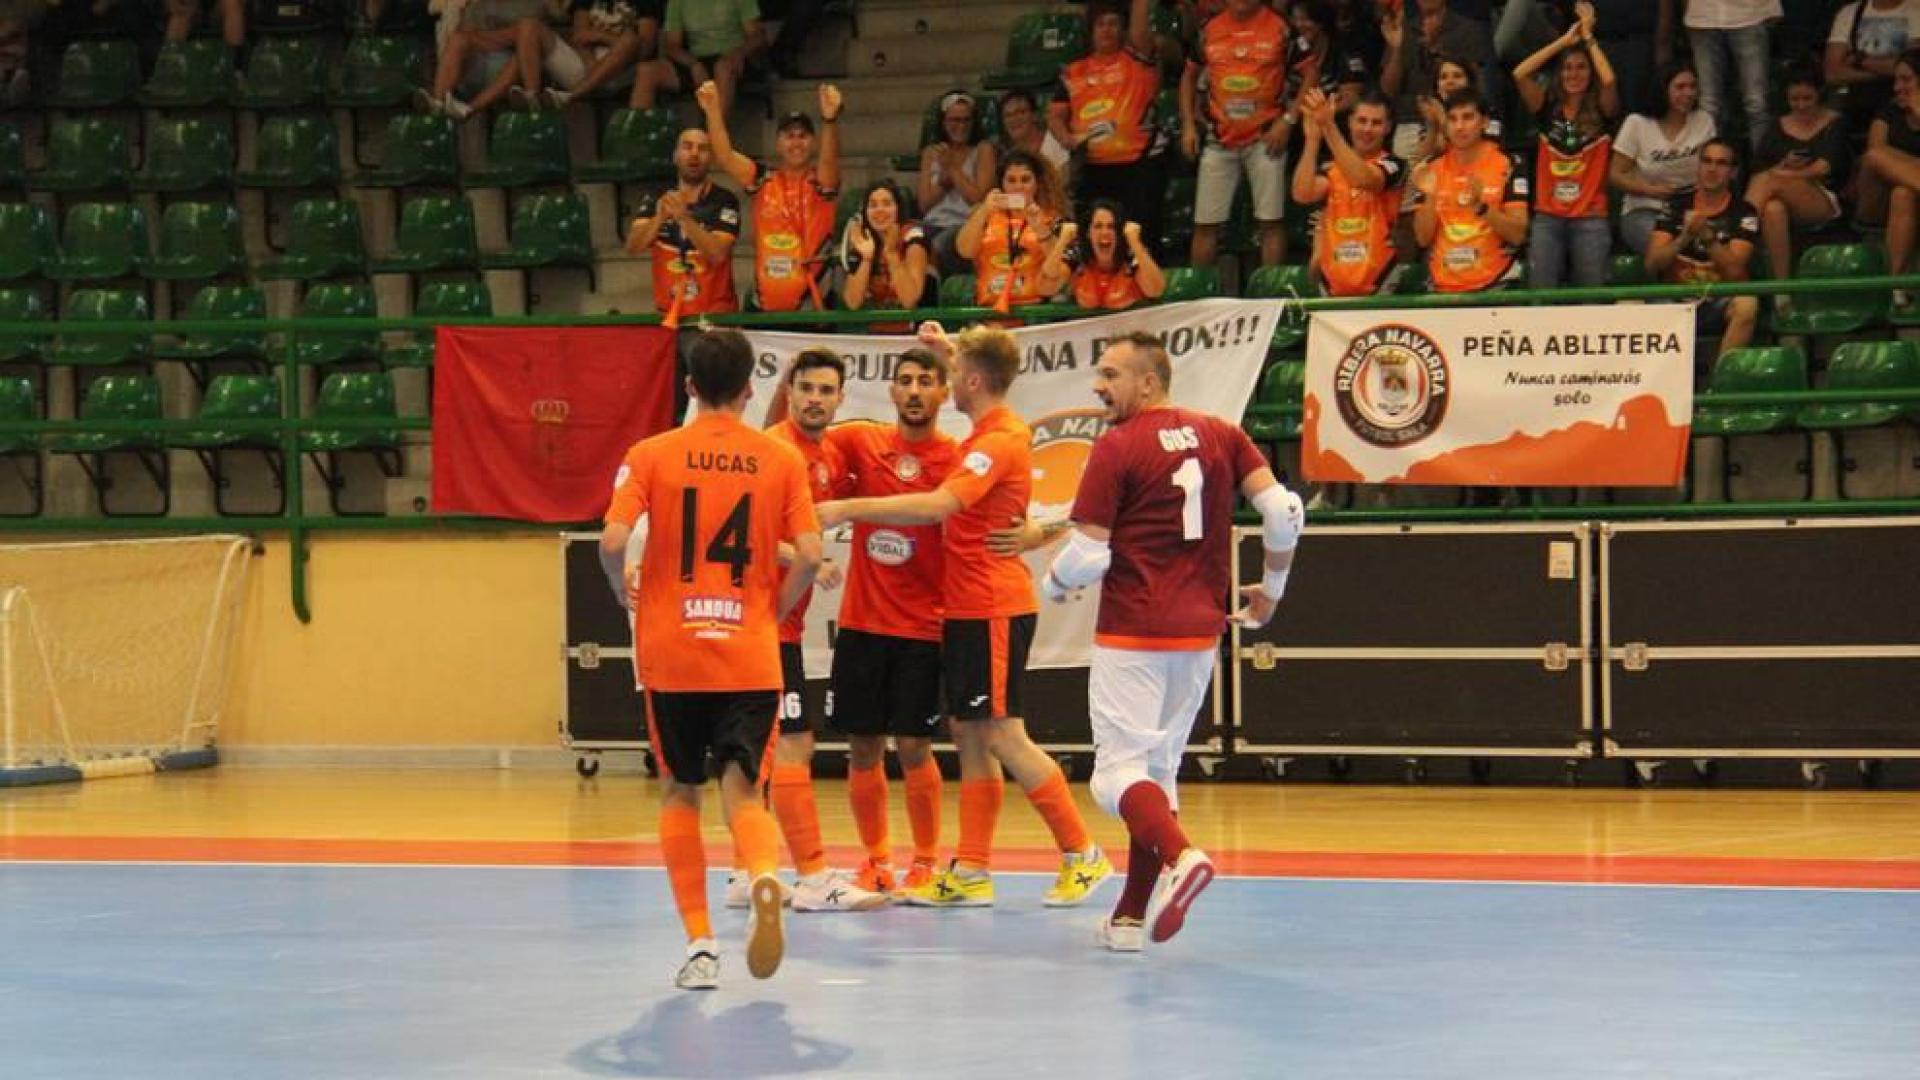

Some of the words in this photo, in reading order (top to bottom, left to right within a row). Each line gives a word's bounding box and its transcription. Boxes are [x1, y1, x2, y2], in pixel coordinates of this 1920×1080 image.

[1463, 329, 1535, 358] PEÑA
[1543, 332, 1682, 356] ABLITERA
[1337, 332, 1380, 391] RIBERA
[1385, 328, 1446, 397] NAVARRA
[1504, 370, 1556, 386] Nunca
[1552, 390, 1592, 407] solo
[1158, 425, 1200, 451] GUS
[686, 450, 759, 475] LUCAS
[1171, 456, 1204, 541] 1
[680, 486, 753, 588] 14
[869, 540, 906, 557] VIDAL
